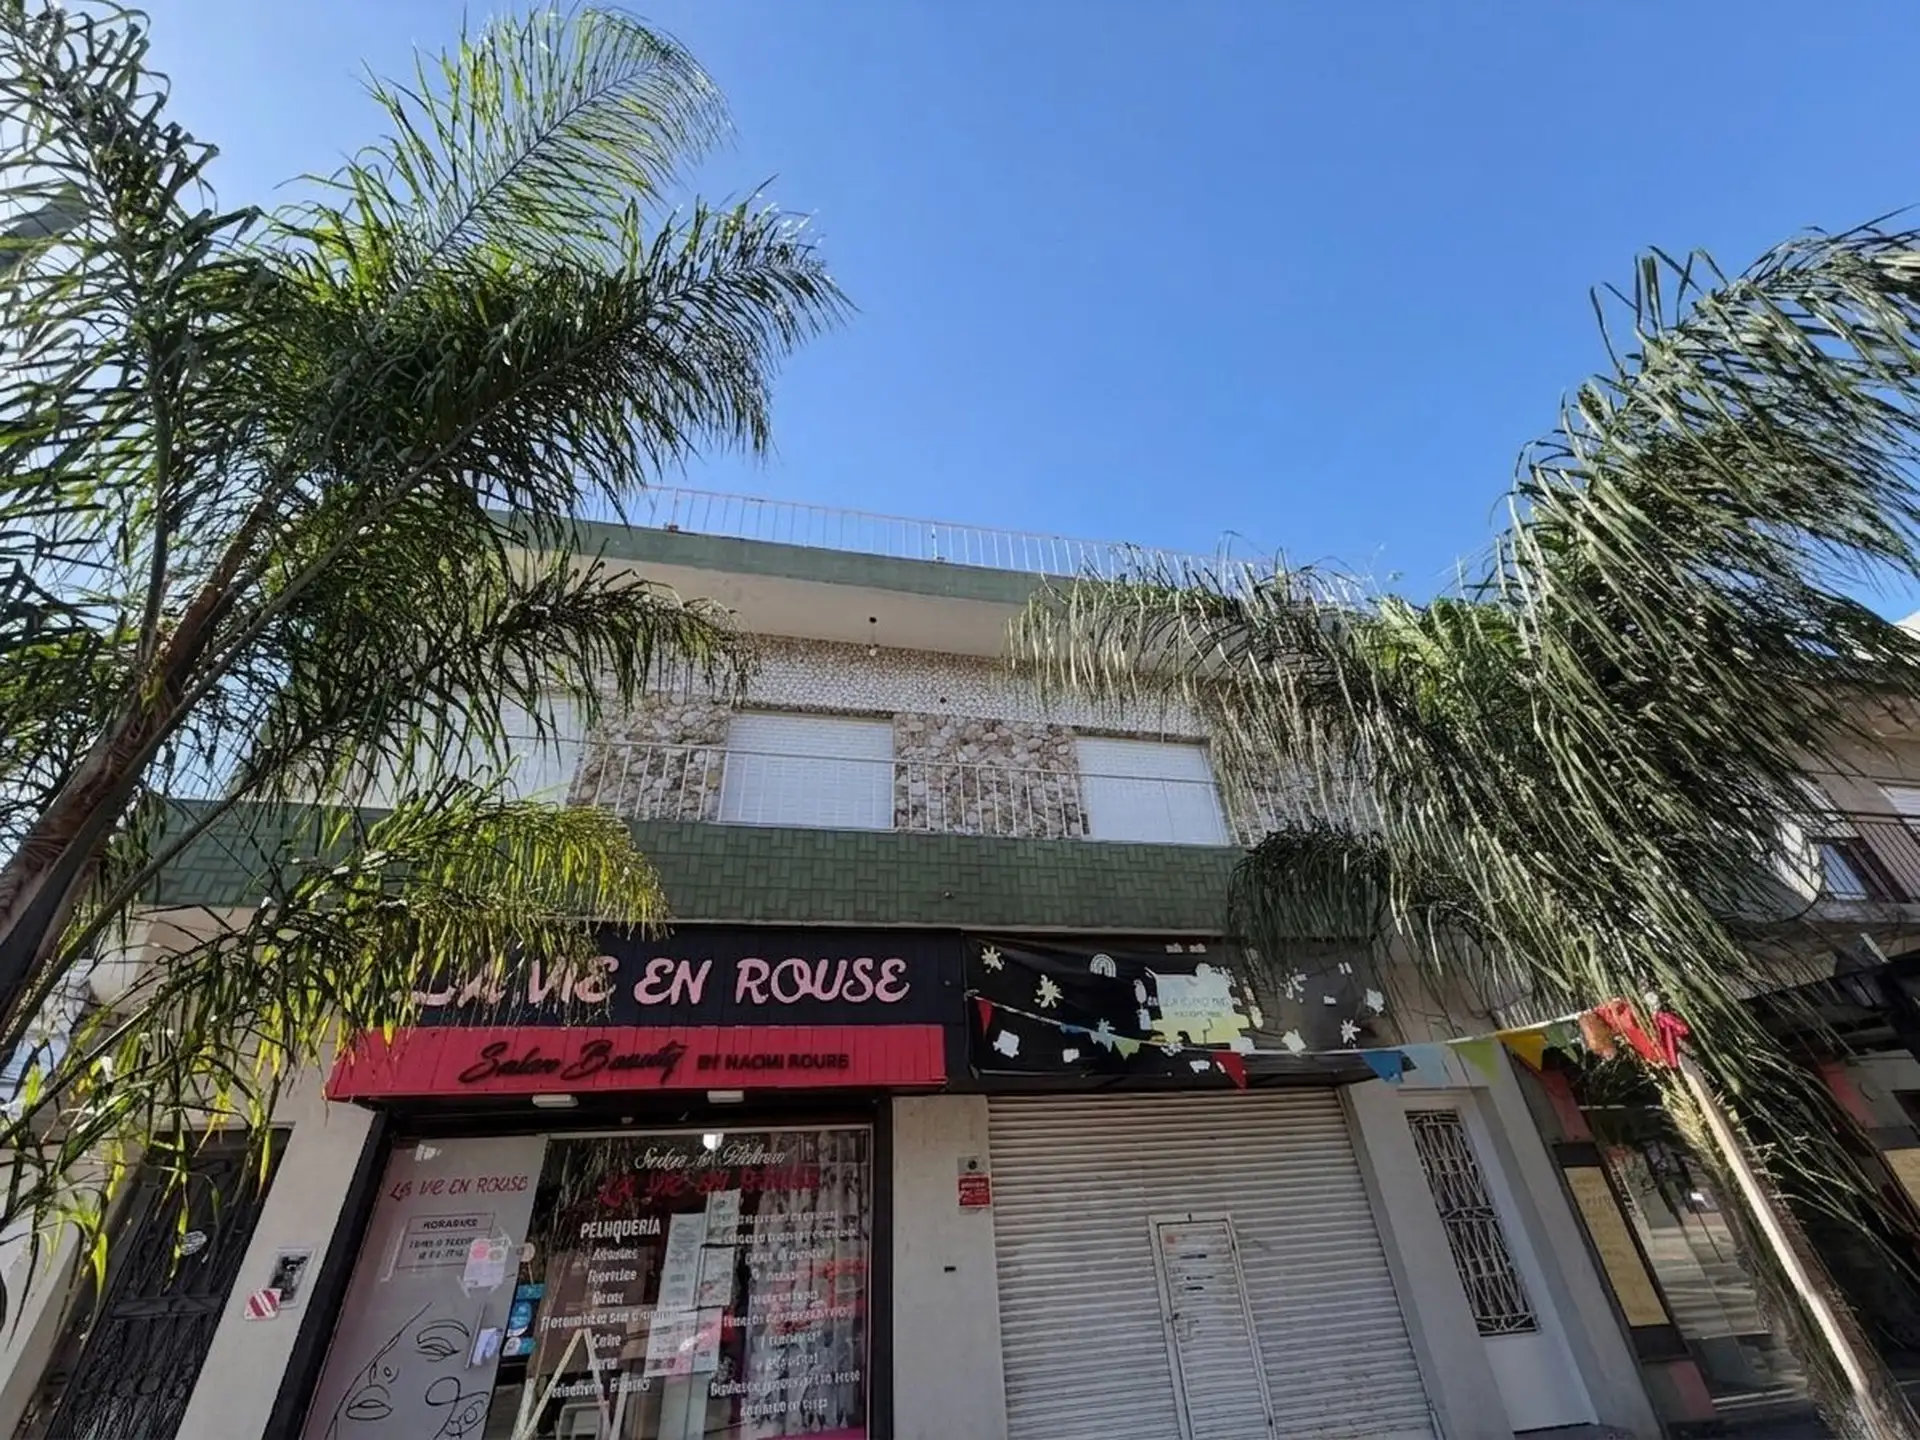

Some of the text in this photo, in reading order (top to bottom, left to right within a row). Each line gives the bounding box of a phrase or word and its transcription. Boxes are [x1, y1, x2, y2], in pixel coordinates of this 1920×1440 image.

[634, 957, 713, 1005] EN
[735, 957, 910, 1004] ROUSE
[458, 1041, 561, 1083] Salon
[560, 1039, 689, 1085] Beauty
